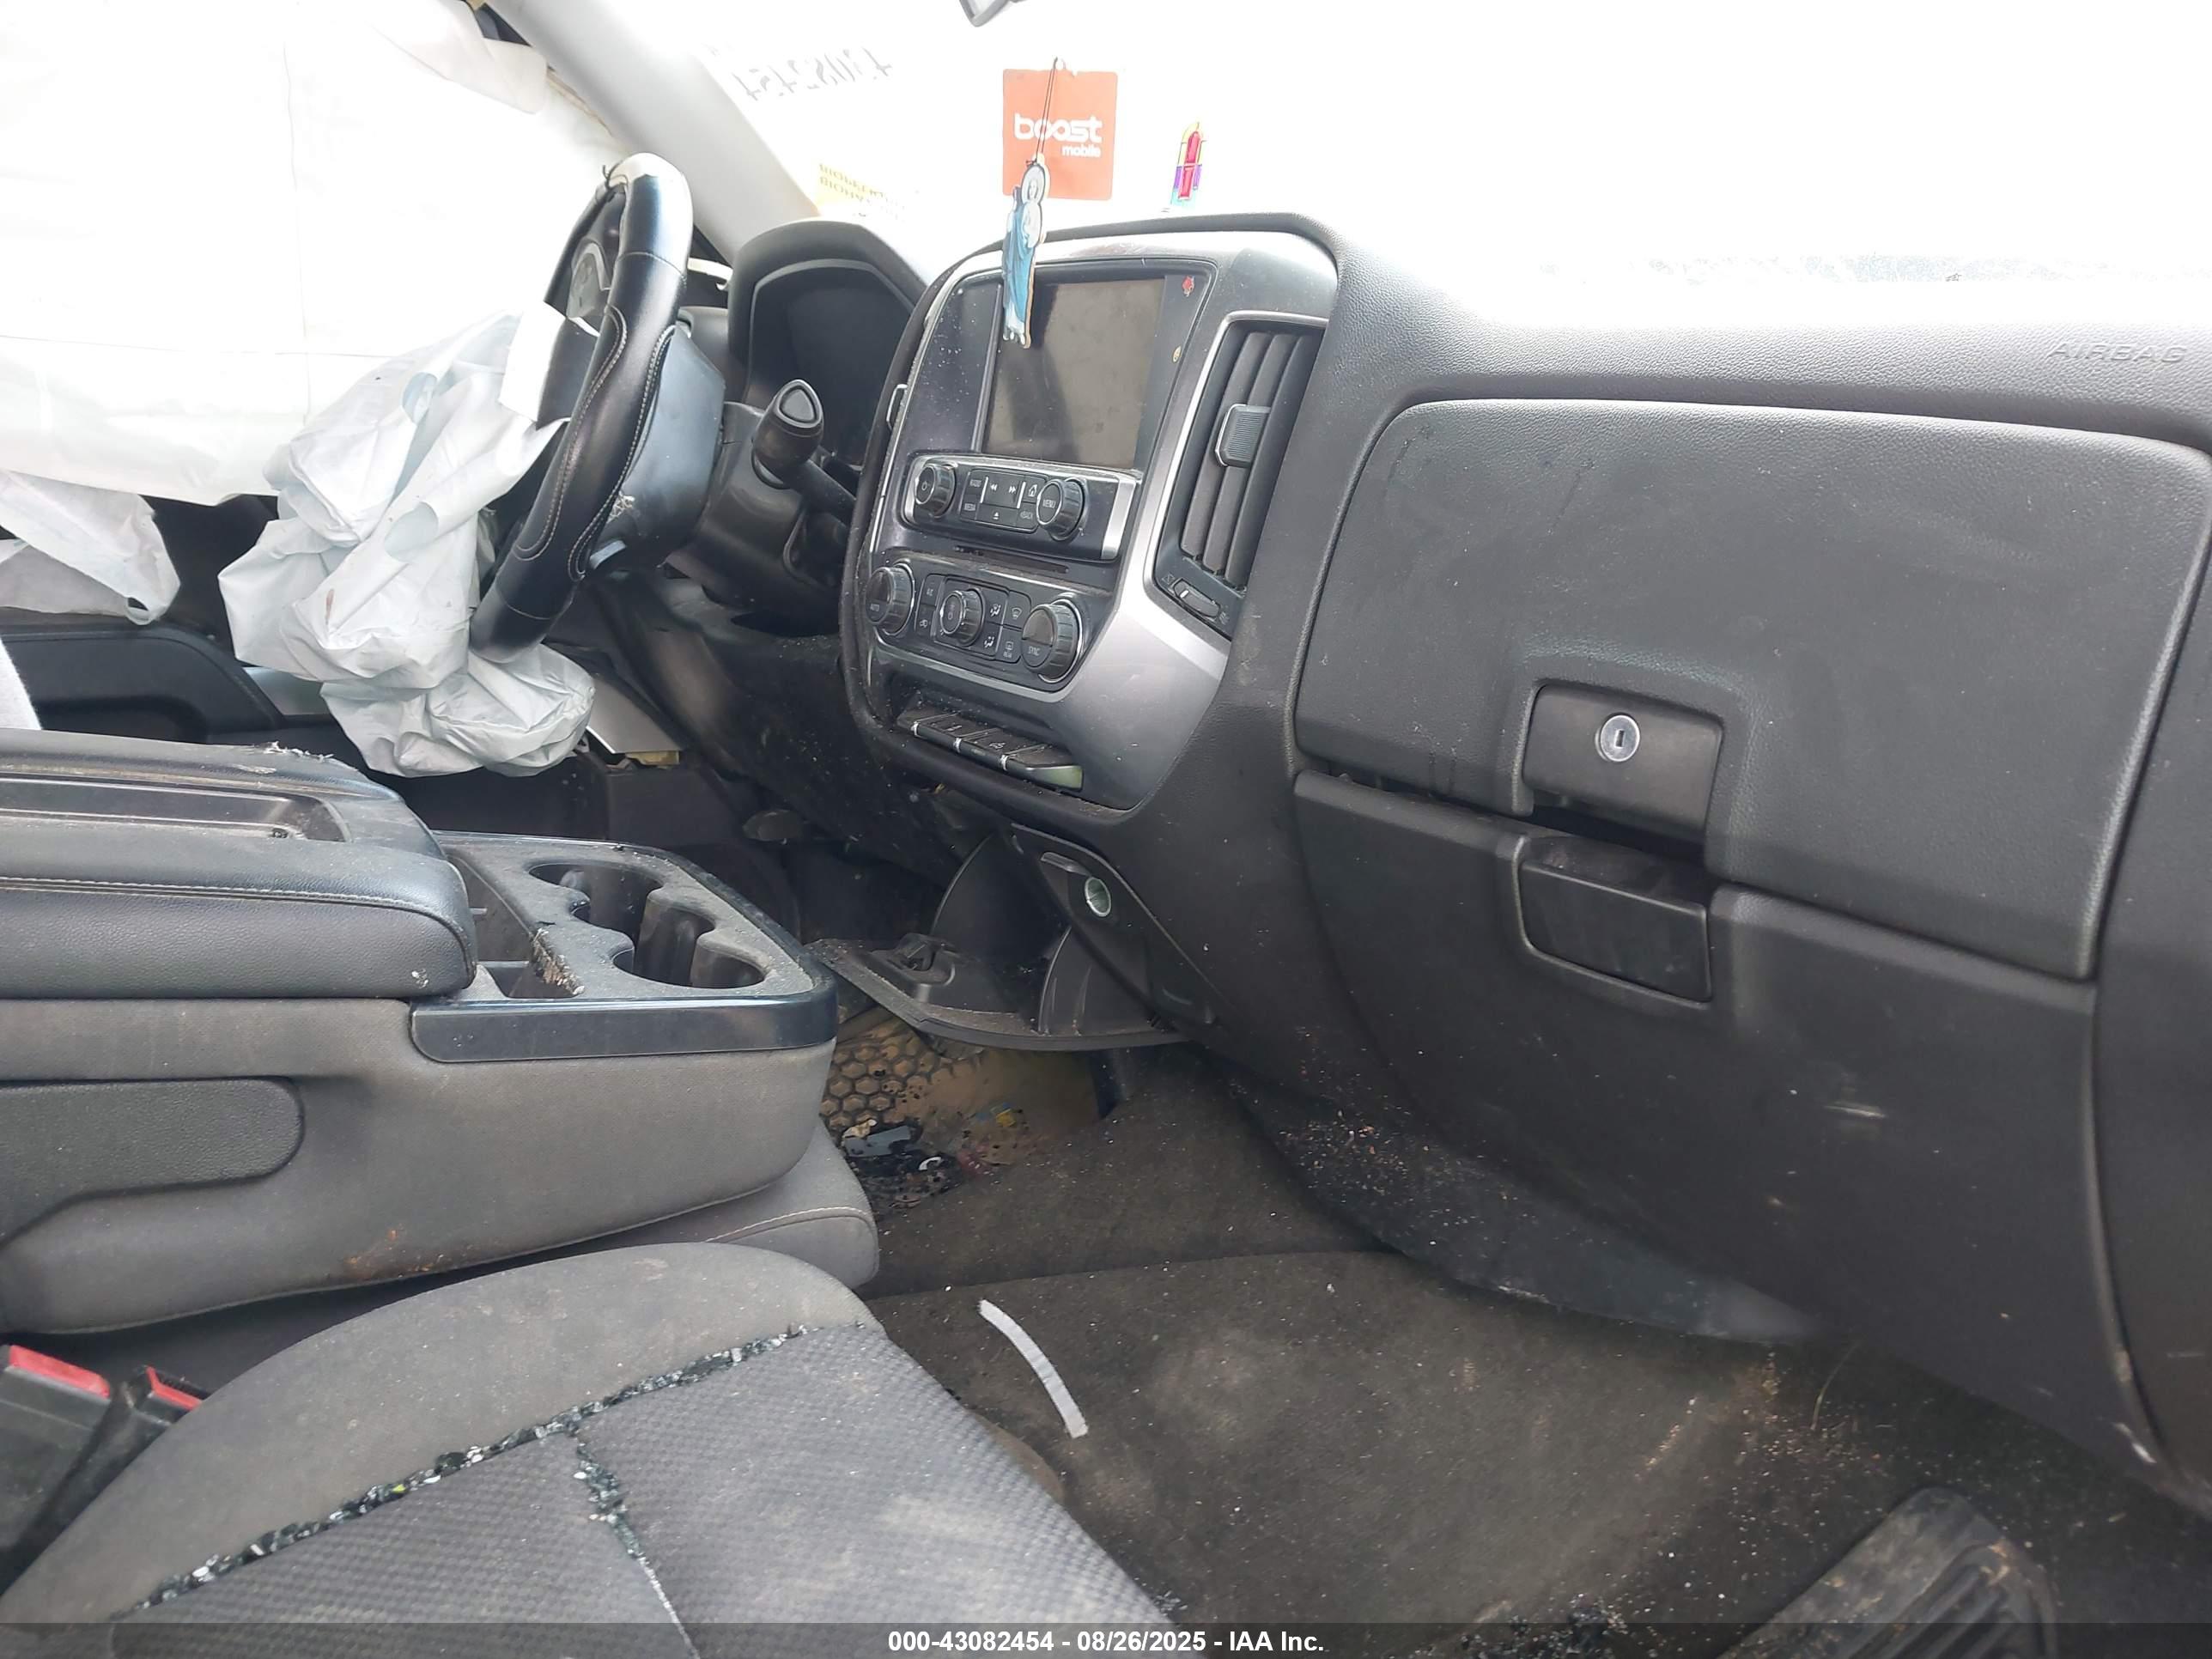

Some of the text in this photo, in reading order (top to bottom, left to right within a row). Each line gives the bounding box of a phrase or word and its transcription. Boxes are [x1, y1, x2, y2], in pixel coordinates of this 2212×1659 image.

[1014, 112, 1103, 143] boost
[1061, 144, 1102, 158] mobile
[2046, 343, 2188, 363] AIRBAG
